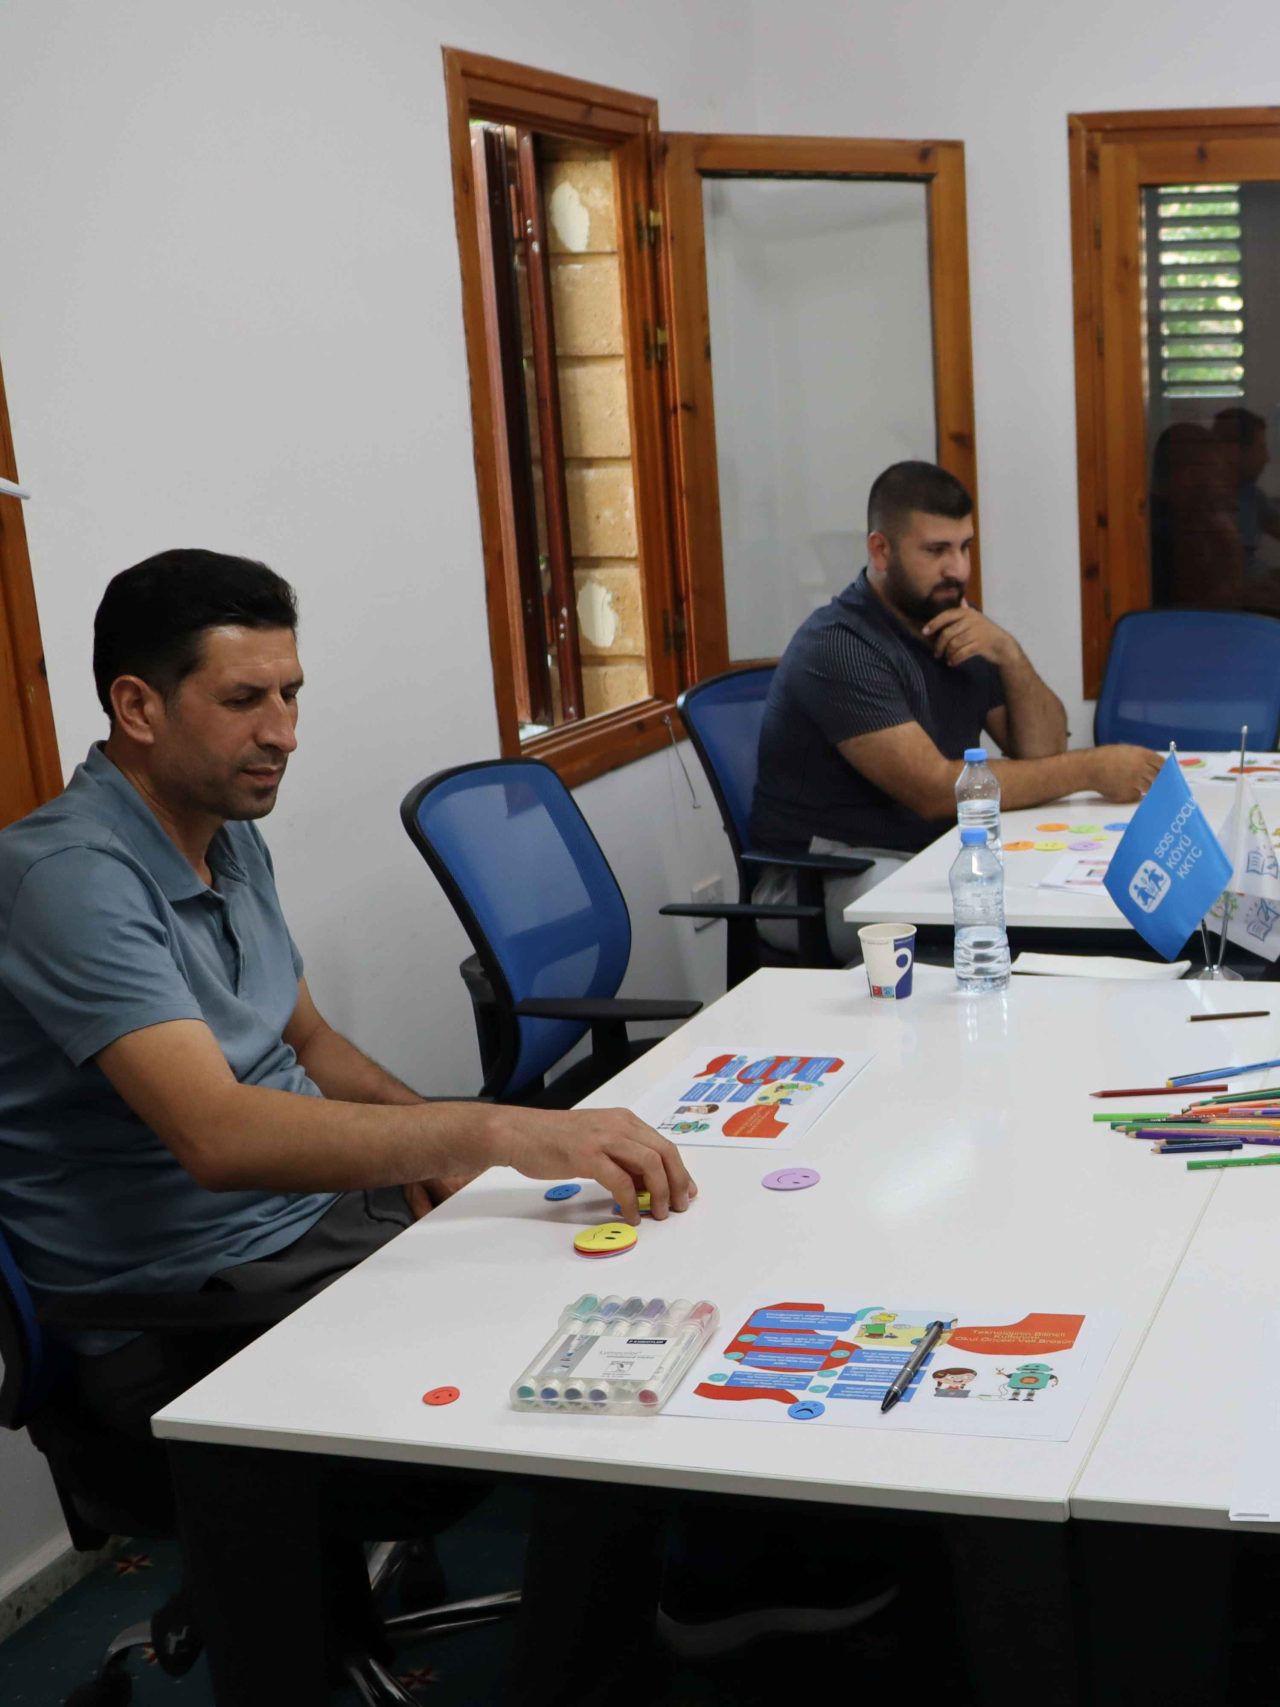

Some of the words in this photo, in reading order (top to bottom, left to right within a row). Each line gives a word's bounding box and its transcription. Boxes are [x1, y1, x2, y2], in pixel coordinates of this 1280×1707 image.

[1154, 832, 1175, 858] SOS
[1170, 798, 1197, 834] ÇOCU
[1165, 834, 1192, 869] KÖYÜ
[1176, 846, 1202, 879] KKTC
